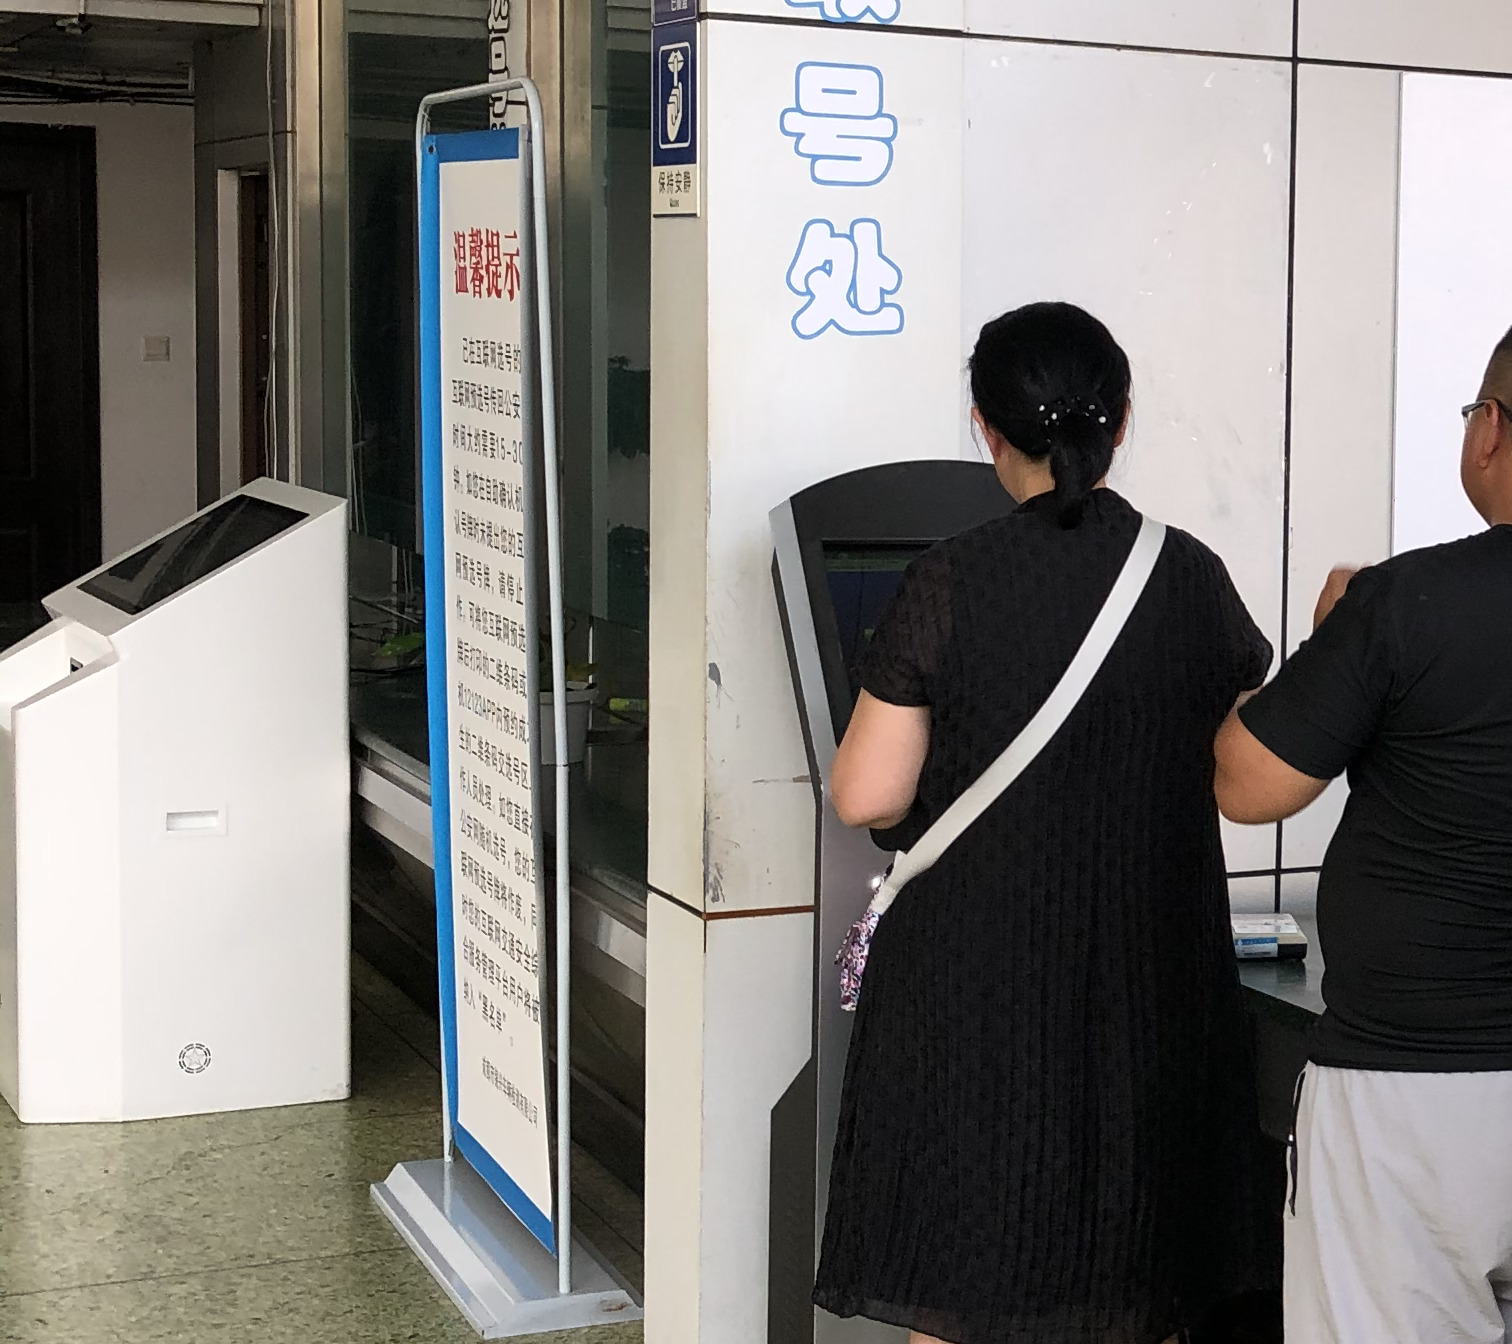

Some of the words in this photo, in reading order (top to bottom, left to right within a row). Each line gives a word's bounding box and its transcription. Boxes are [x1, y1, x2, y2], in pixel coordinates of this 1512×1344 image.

[658, 170, 692, 194] 保持安静
[453, 227, 520, 302] 温馨提示
[458, 681, 529, 745] 机12123APP内预约成
[459, 724, 531, 790] 生的二维条码交选号区
[459, 765, 532, 836] 作人员处理。如您直接
